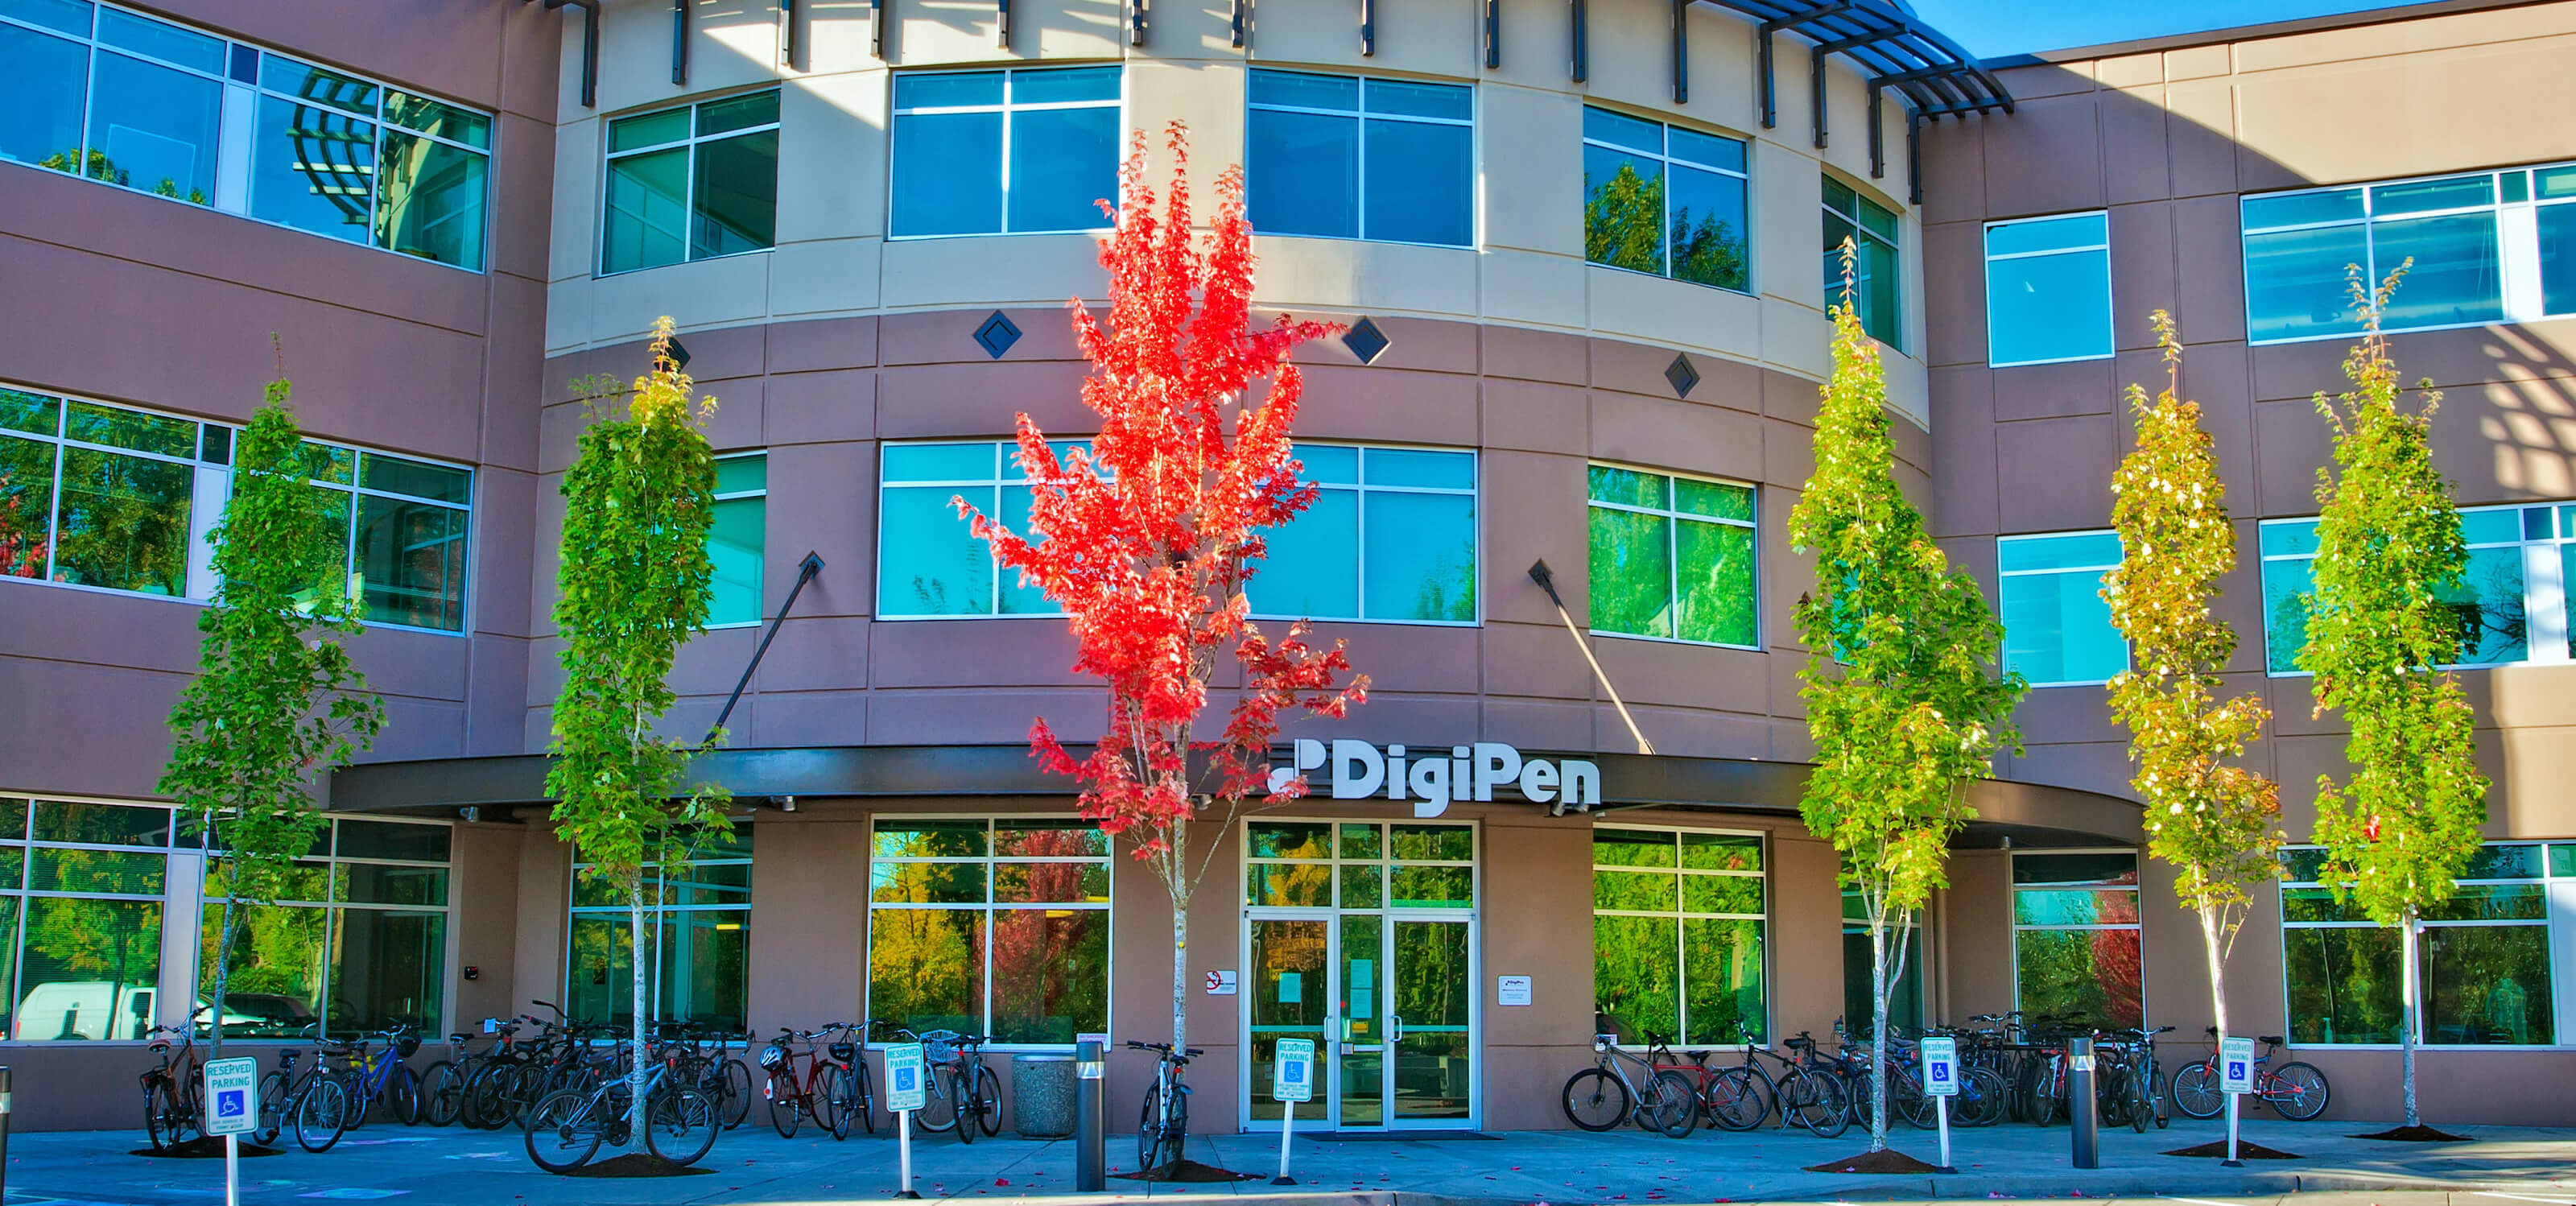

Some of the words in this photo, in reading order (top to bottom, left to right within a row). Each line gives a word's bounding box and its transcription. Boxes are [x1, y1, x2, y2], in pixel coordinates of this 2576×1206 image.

[1332, 738, 1601, 819] DigiPen
[1279, 1043, 1311, 1052] RESERVED
[1281, 1052, 1310, 1062] PARKING
[207, 1064, 251, 1076] RESERVED
[212, 1076, 250, 1088] PARKING
